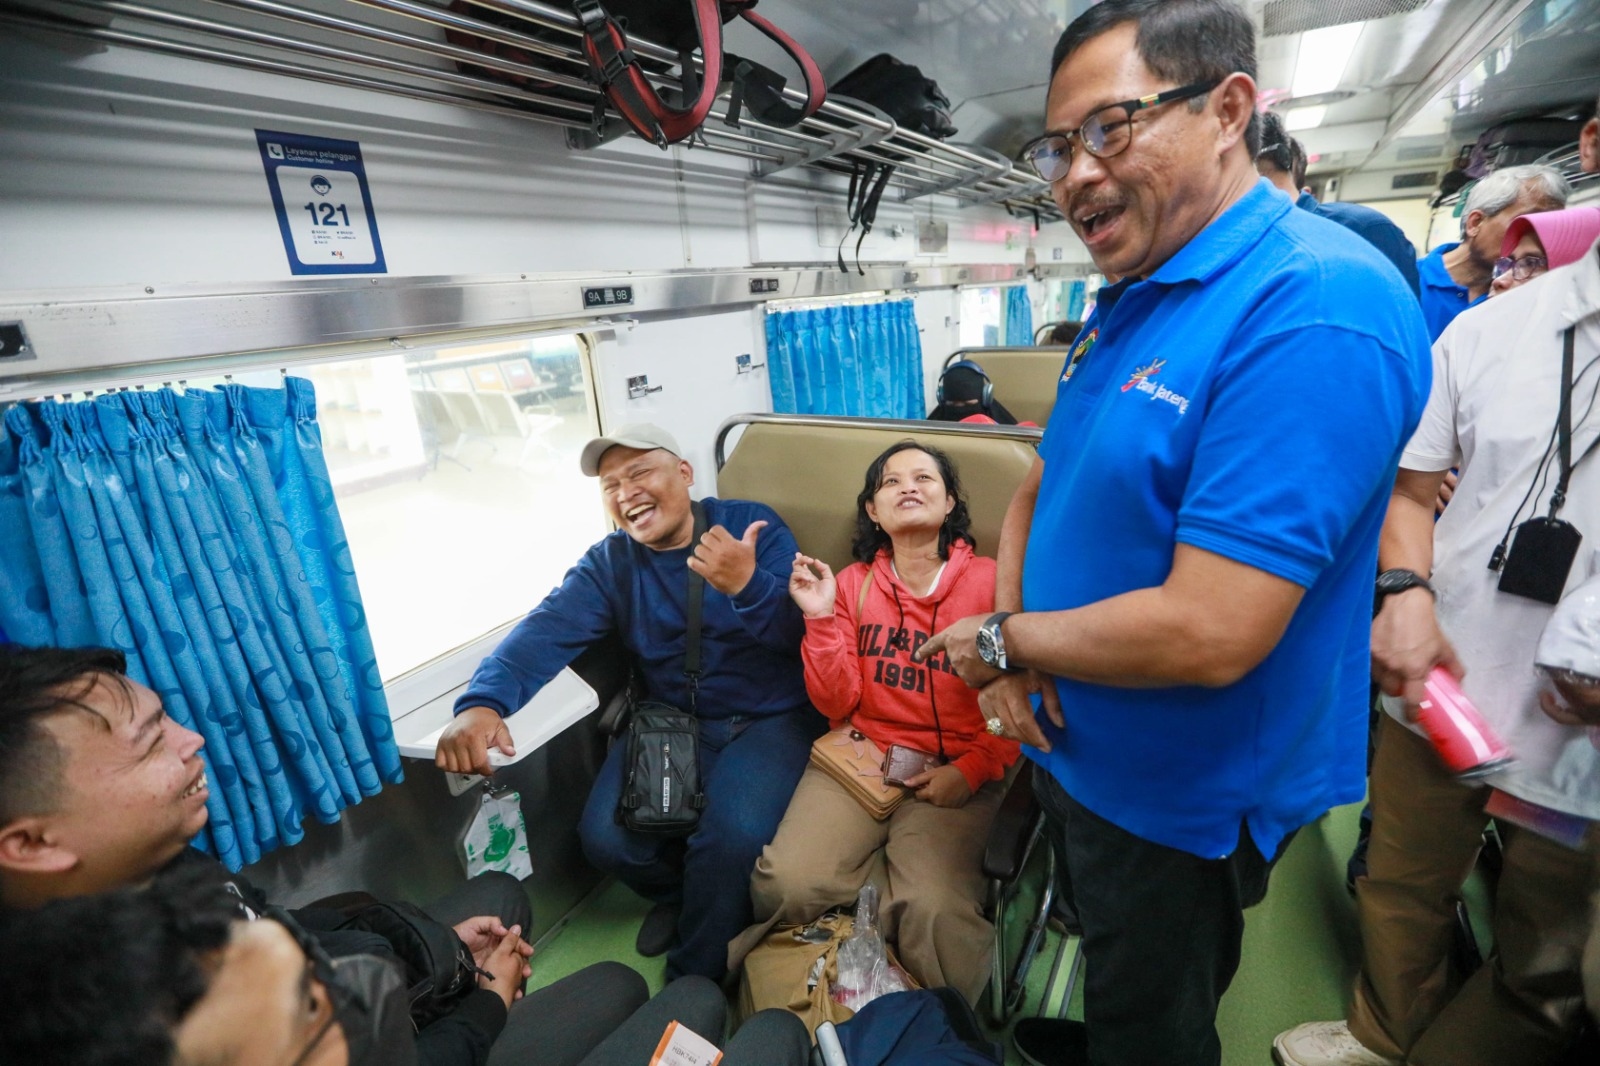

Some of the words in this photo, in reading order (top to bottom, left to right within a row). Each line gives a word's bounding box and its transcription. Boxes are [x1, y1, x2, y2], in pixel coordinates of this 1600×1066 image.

[285, 146, 318, 156] Layanan
[319, 151, 357, 161] pelanggan
[286, 154, 314, 163] Customer
[304, 202, 350, 226] 121
[588, 291, 601, 302] 9A
[616, 290, 628, 300] 9B
[873, 660, 926, 693] 1991
